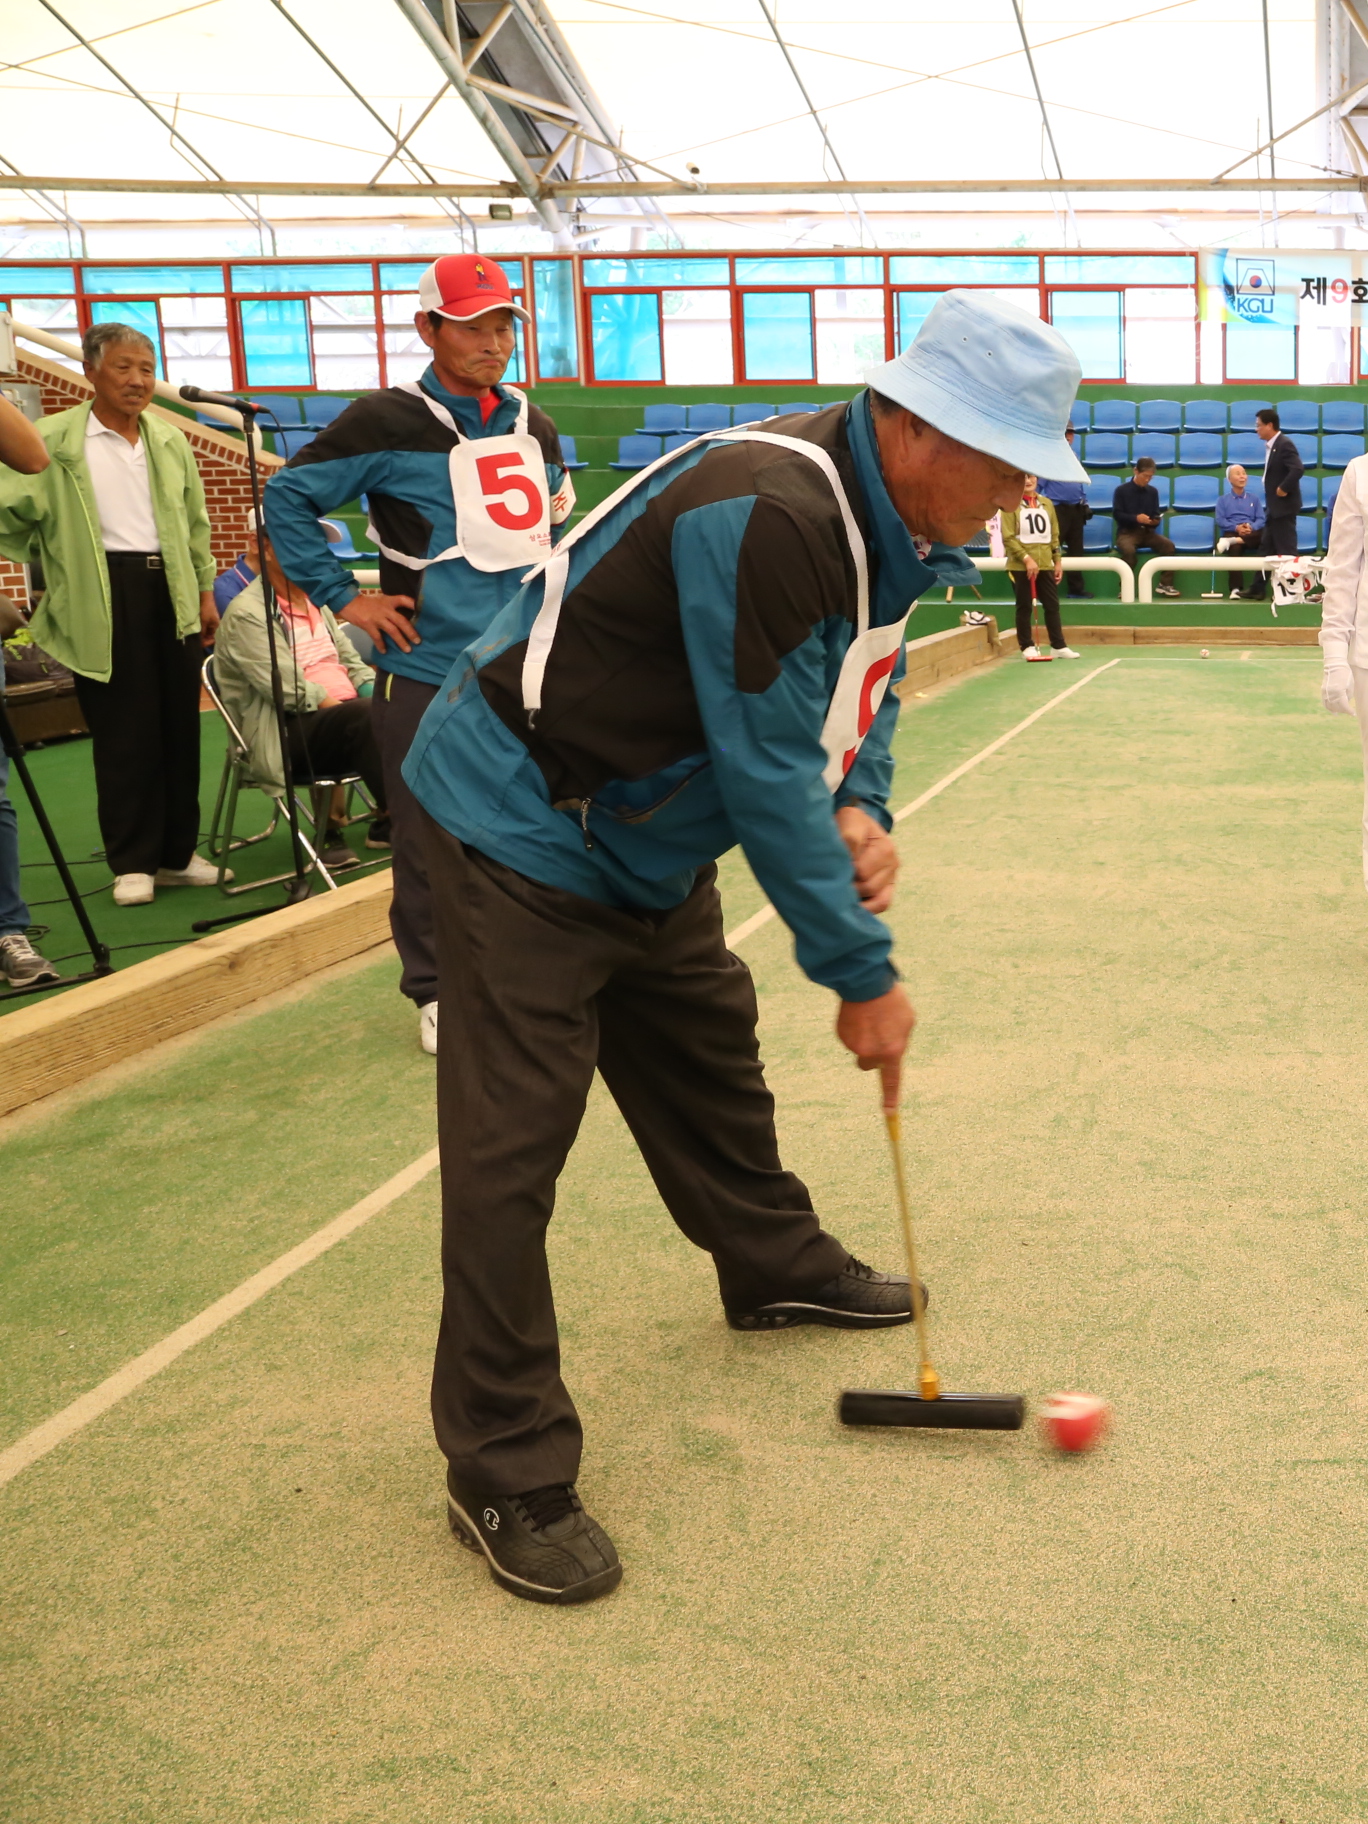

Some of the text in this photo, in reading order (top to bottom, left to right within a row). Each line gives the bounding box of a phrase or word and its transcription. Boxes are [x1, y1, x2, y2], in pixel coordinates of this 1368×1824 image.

[1236, 297, 1274, 314] KGU
[475, 451, 543, 531] 5
[1025, 513, 1047, 534] 10
